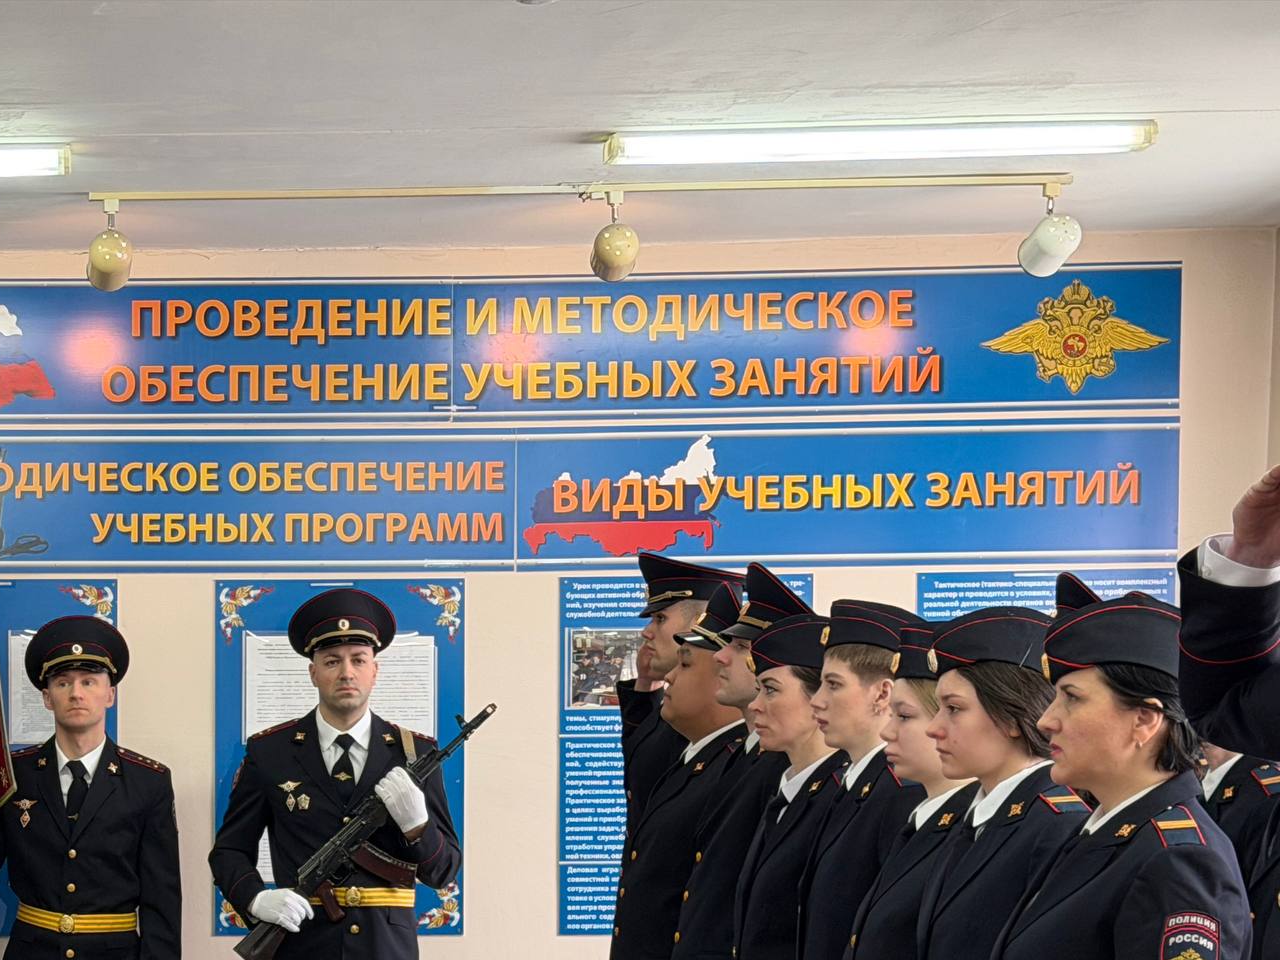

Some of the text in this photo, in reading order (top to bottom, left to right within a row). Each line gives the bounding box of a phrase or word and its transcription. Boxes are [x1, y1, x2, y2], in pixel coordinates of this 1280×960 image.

[130, 289, 914, 345] ПРОВЕДЕНИЕ И МЕТОДИЧЕСКОЕ
[101, 346, 941, 403] ОБЕСПЕЧЕНИЕ УЧЕБНЫХ ЗАНЯТИЙ
[228, 461, 504, 492] ОБЕСПЕЧЕНИЕ
[553, 463, 1140, 519] ВИДЫ УЧЕБНЫХ ЗАНЯТИЙ
[91, 512, 504, 545] УЧЕБНЫХ ПРОГРАММ
[923, 600, 959, 608] реальной
[924, 591, 958, 599] характер
[965, 591, 1009, 599] проводится
[566, 611, 606, 620] служебной
[565, 742, 616, 750] Практическое
[1168, 915, 1217, 932] ПОЛИЦИЯ
[1168, 933, 1214, 951] РОССИЯ
